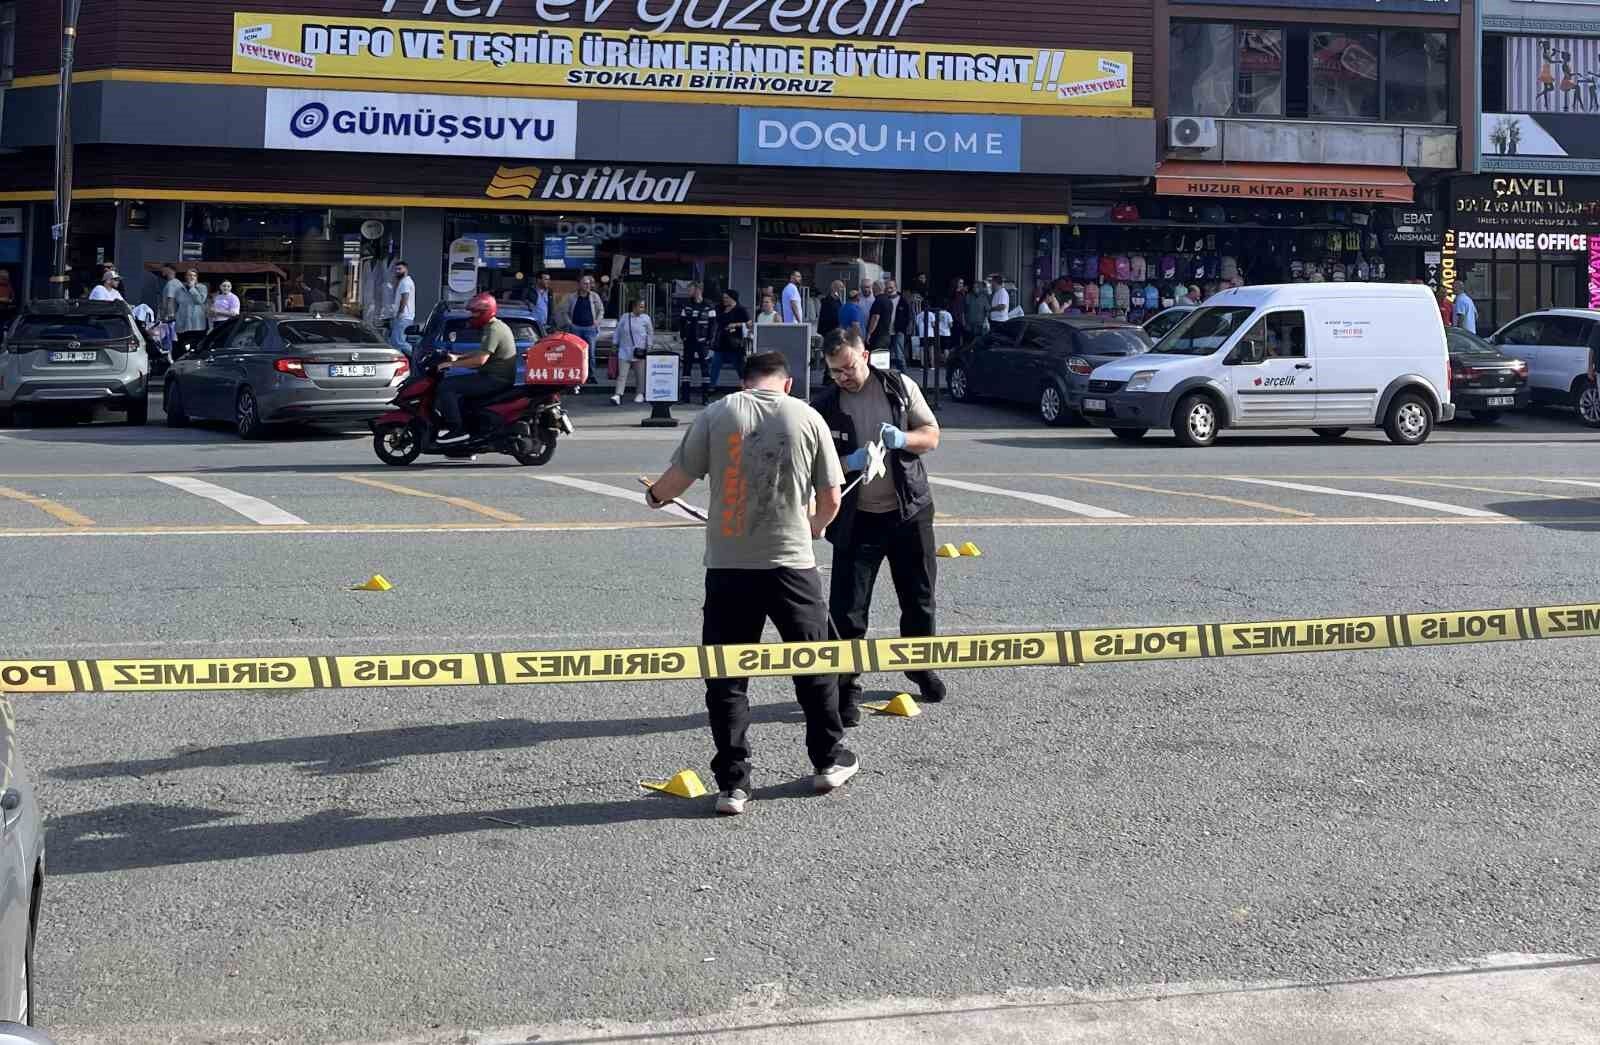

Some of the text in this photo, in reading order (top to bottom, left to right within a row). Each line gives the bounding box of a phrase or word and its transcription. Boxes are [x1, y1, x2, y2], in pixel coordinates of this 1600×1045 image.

[302, 24, 394, 58] DEPO
[399, 28, 445, 61] VE
[449, 30, 574, 67] TEŞHİR
[581, 32, 805, 74] ÜRÜNLERİNDE
[810, 44, 921, 80] BÜYÜK
[567, 69, 834, 94] STOKLARI BİTİRİYORUZ
[332, 106, 555, 144] GÜMÜŞSUYU
[758, 119, 1004, 156] DOQU HOME
[541, 165, 697, 202] istikbal
[1187, 183, 1385, 199] HUZUR KİTAP KIRTASİYE
[1403, 213, 1433, 225] EBAT
[1458, 232, 1588, 251] EXCHANGE OFFICE
[528, 368, 581, 379] 444 16 42
[1264, 374, 1296, 388] arçelik
